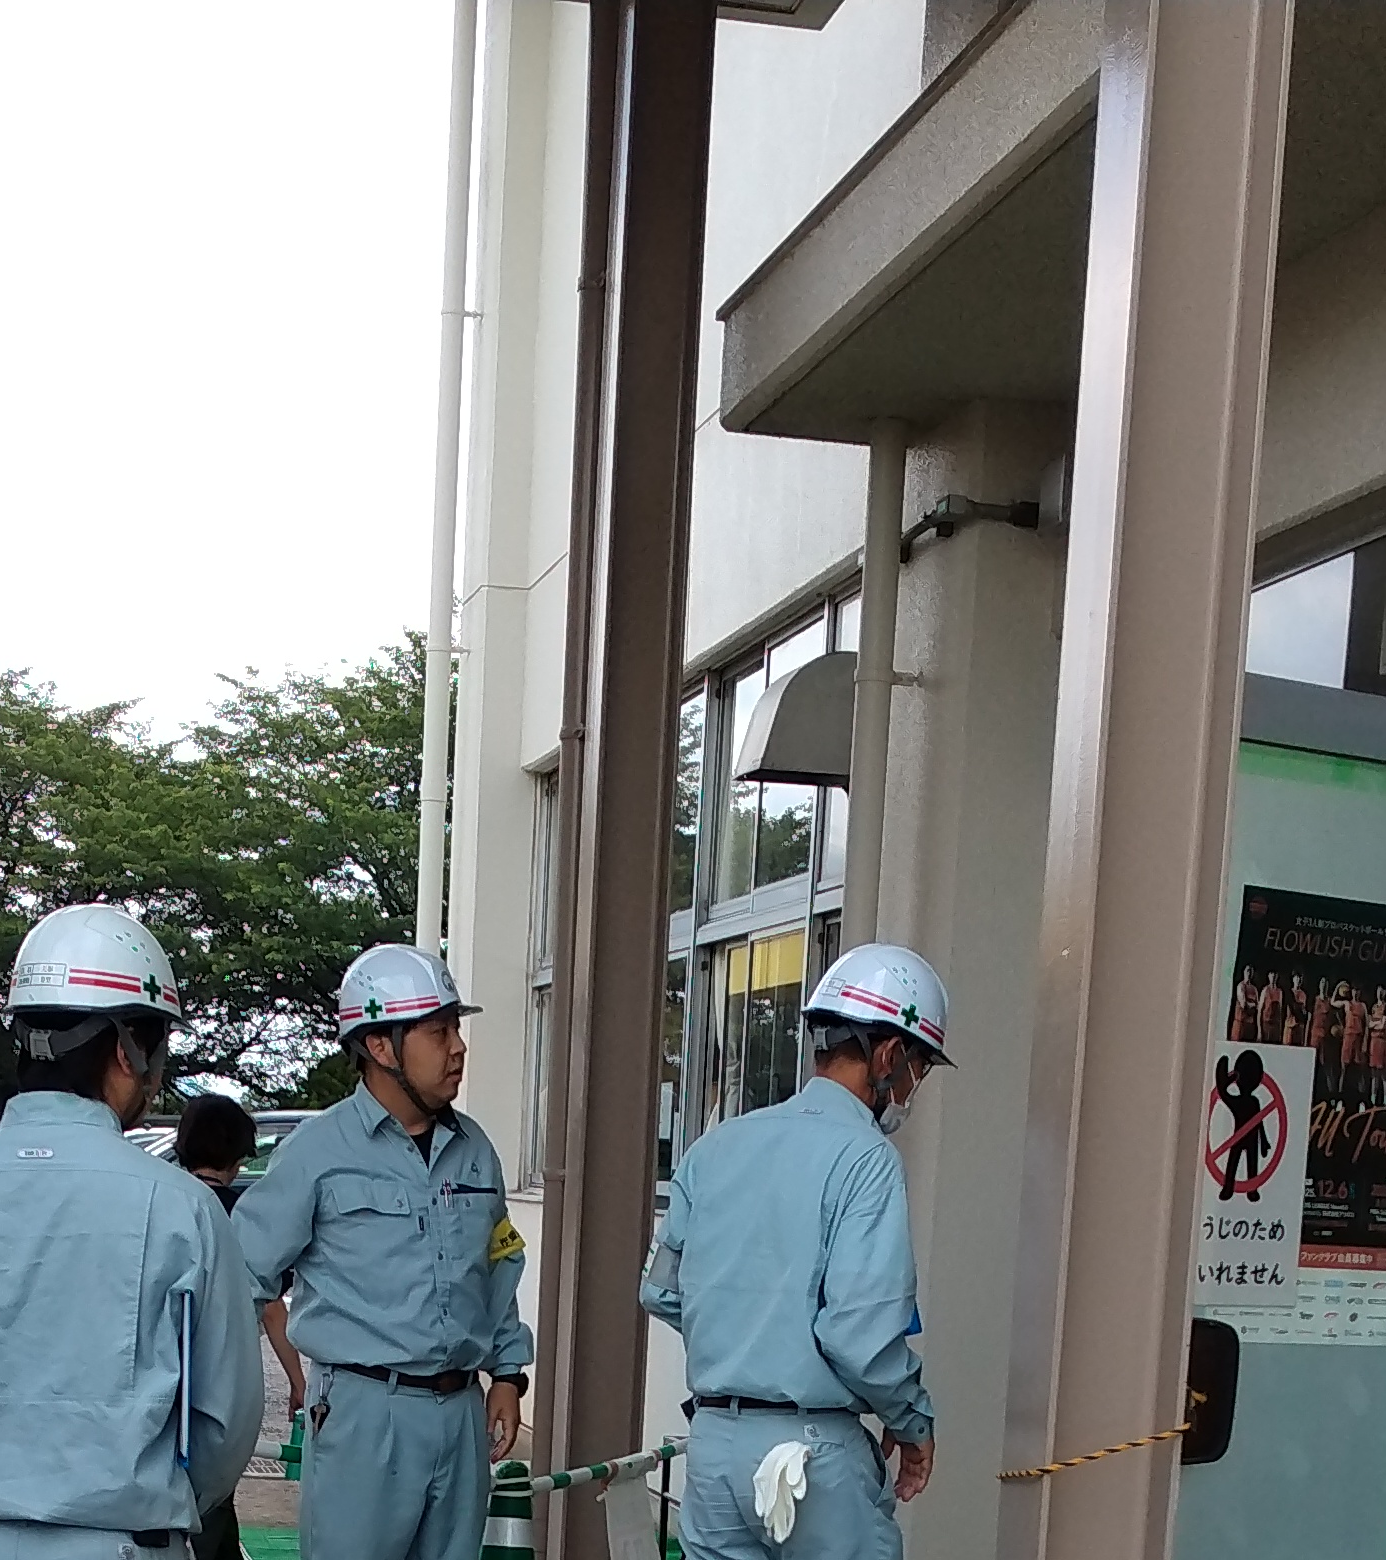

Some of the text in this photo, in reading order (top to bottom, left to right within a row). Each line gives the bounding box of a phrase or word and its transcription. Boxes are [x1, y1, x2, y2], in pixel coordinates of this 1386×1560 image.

[1202, 1215, 1286, 1242] うじのため
[1197, 1261, 1286, 1286] いれません
